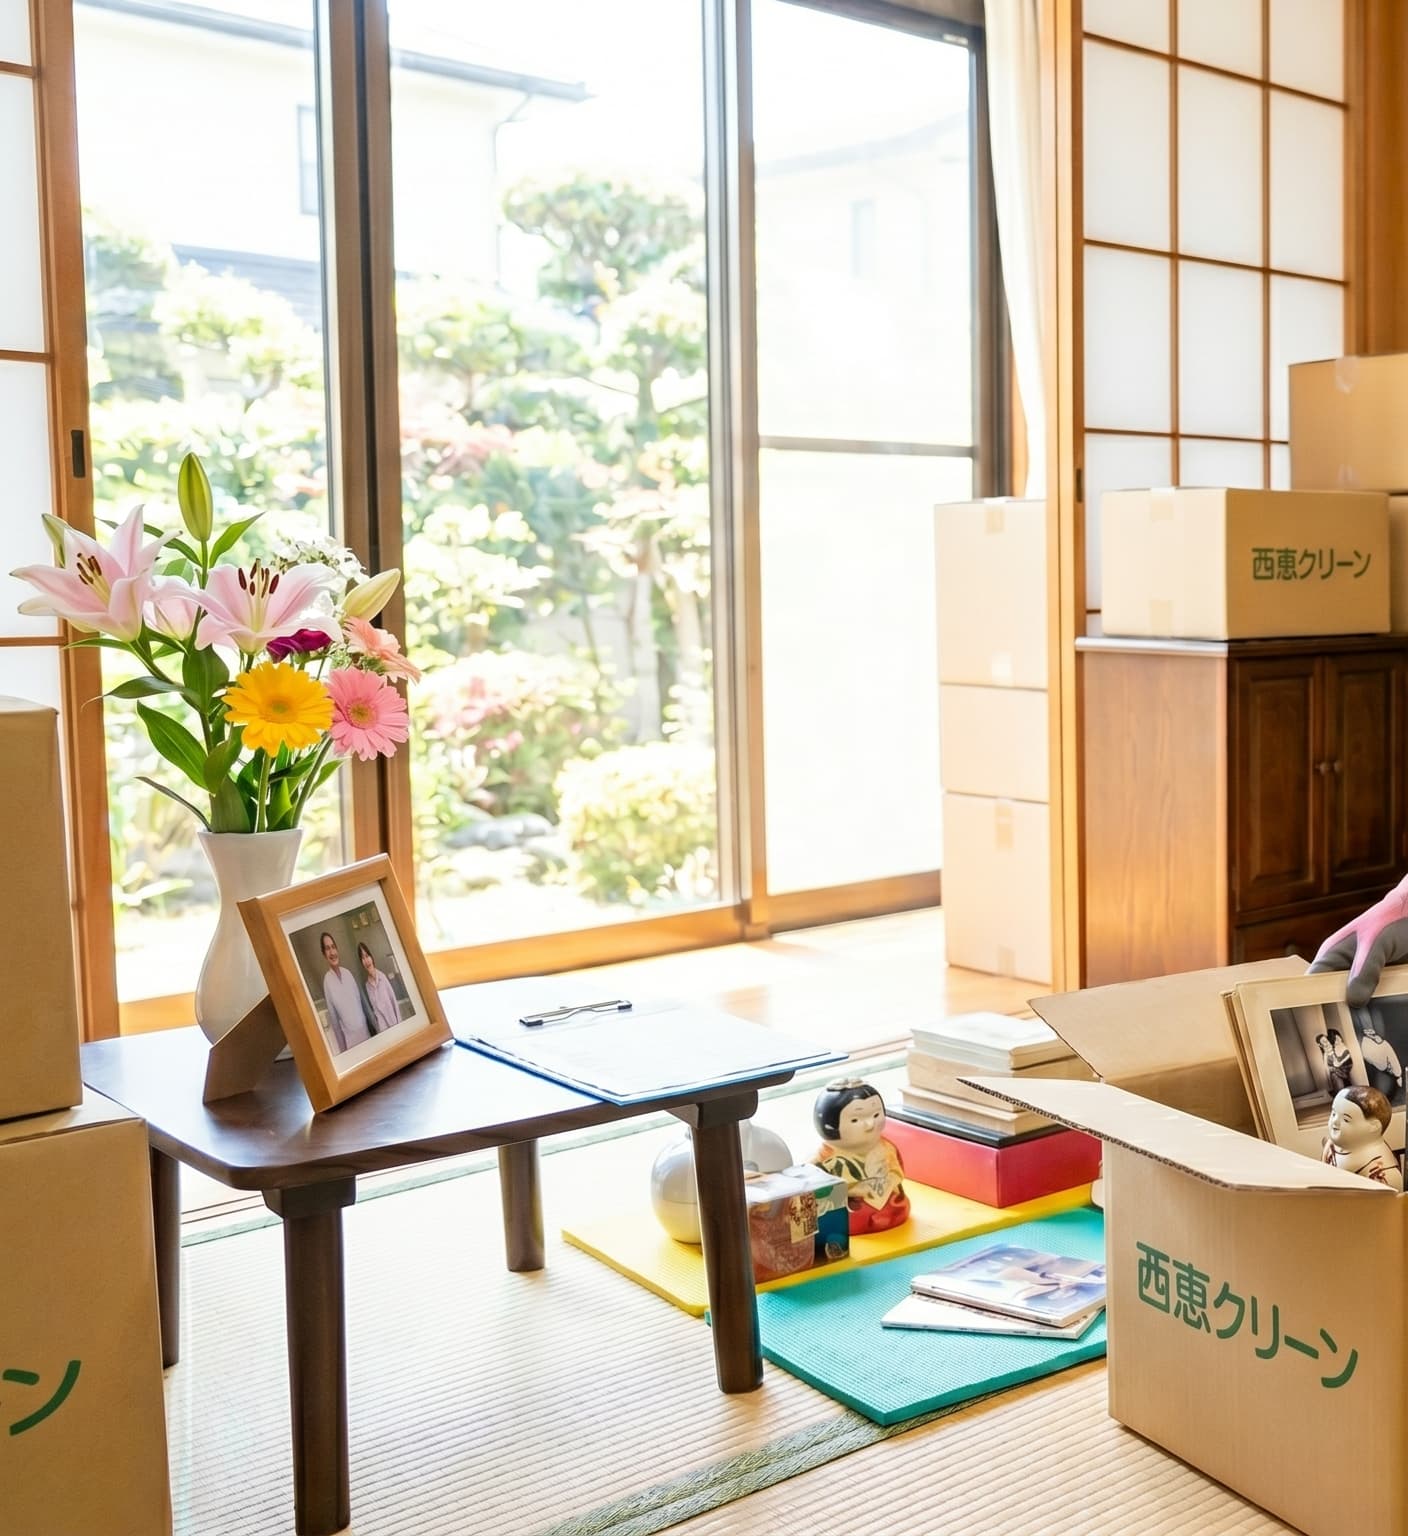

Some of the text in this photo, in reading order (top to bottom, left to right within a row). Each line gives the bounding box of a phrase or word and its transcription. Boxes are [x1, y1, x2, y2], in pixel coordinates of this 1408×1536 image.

[1252, 548, 1371, 580] 西恵クリーン
[1136, 1241, 1358, 1389] 西恵クリーン
